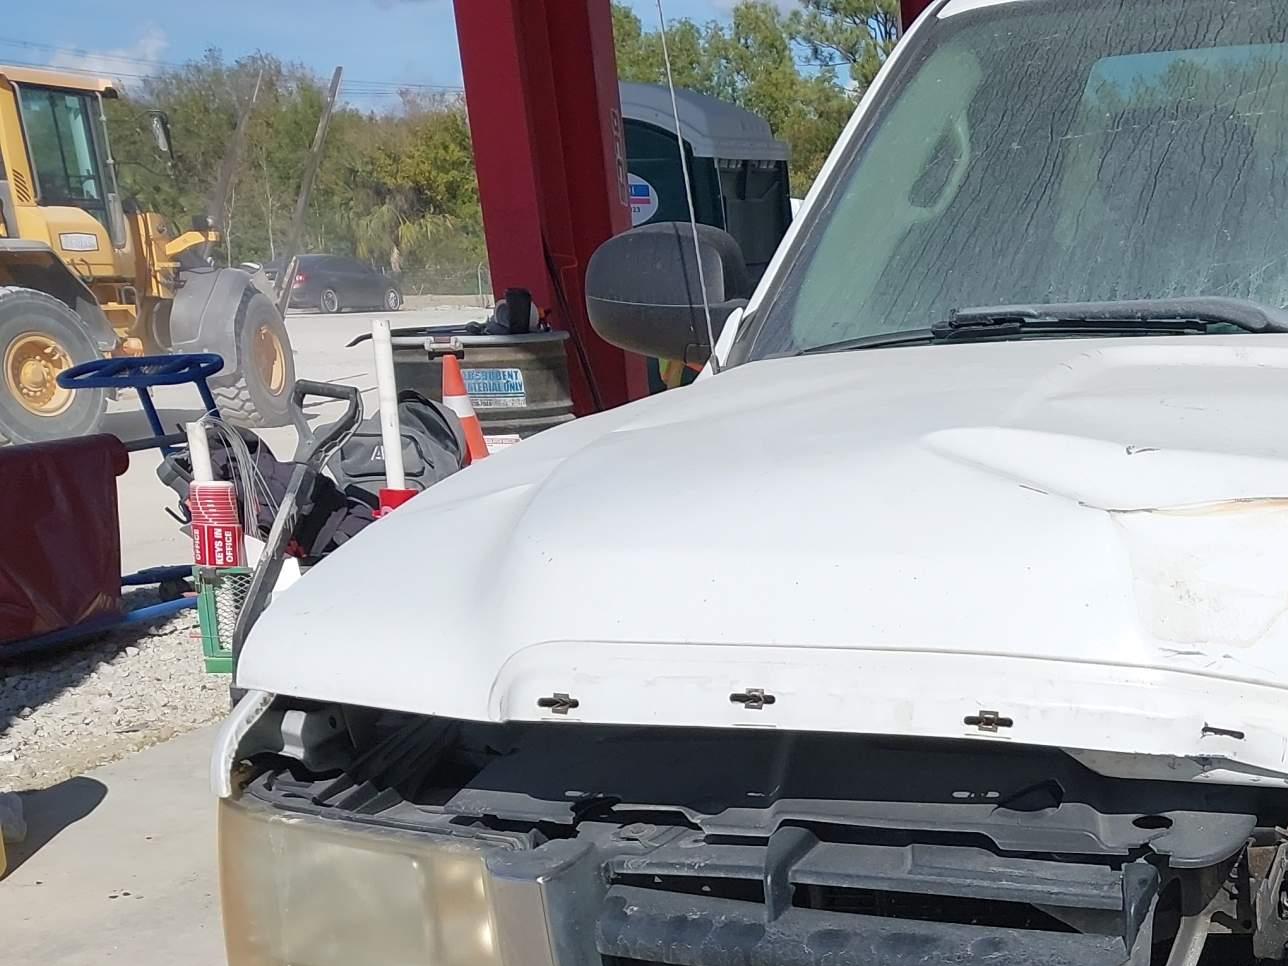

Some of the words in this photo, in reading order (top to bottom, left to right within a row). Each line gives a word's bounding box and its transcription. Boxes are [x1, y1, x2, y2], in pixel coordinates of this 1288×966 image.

[503, 382, 523, 392] ONLY
[193, 528, 201, 561] OFFICE
[213, 527, 223, 539] IN
[214, 540, 225, 565] KEYS
[225, 530, 234, 563] OFFICE
